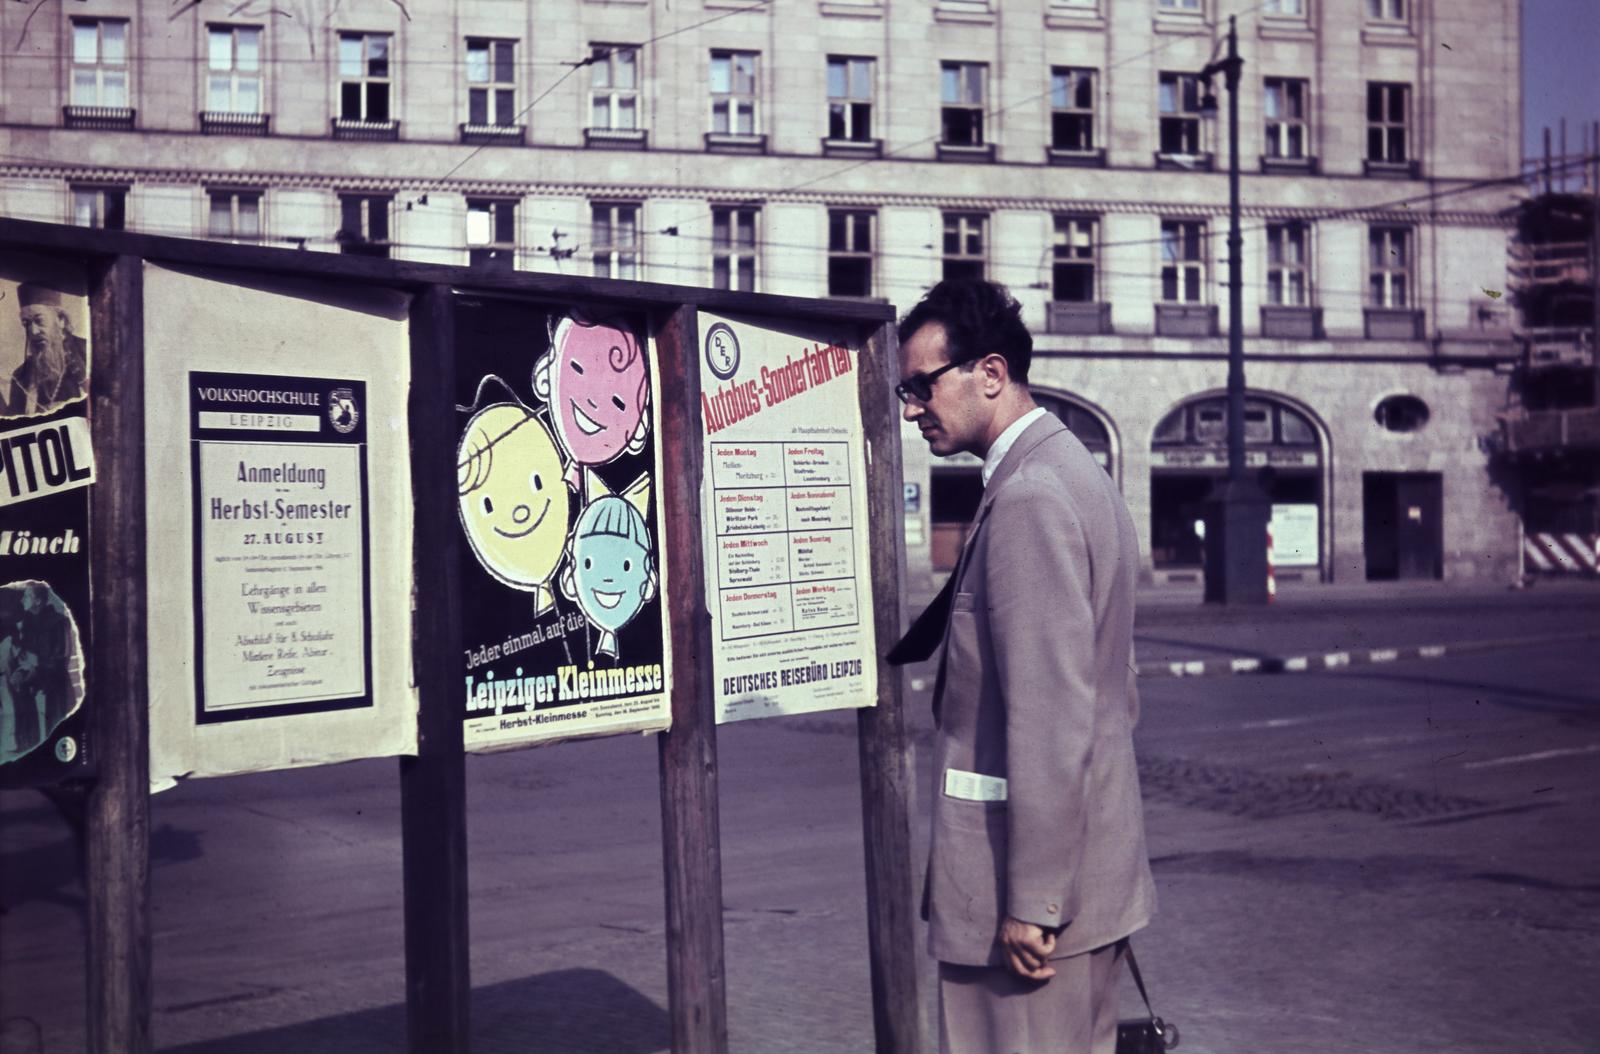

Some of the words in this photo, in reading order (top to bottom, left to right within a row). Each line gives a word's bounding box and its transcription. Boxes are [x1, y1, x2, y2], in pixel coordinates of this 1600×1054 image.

[715, 336, 731, 367] DER
[198, 387, 321, 406] VOLKSHOCHSCHULE
[701, 344, 853, 435] Autobus-Sonderfahrten
[230, 413, 294, 428] LEIPZIG
[0, 424, 91, 498] ITOL
[717, 448, 734, 456] Jeden
[735, 448, 757, 457] Montag
[804, 447, 824, 456] Freitag
[238, 461, 326, 490] Anmeldung
[738, 494, 763, 502] Dienstag
[211, 498, 352, 520] Herbst-Semester
[243, 533, 261, 545] 27.
[263, 532, 324, 545] AUGUST
[723, 541, 739, 549] Jeden
[241, 583, 290, 599] Lehrgänge
[306, 582, 327, 593] allen
[726, 594, 743, 602] Jeden
[796, 587, 812, 595] Jeden
[812, 585, 836, 594] Werktag
[465, 645, 501, 670] Jeder
[502, 624, 546, 656] einmal
[547, 615, 566, 639] auf
[566, 612, 585, 631] die
[724, 671, 778, 695] DEUTSCHES
[781, 661, 828, 687] REISEBÜRO
[831, 659, 862, 679] LEIPZIG
[465, 667, 557, 715] Leipziger
[557, 660, 662, 700] Kleinmesse
[500, 710, 588, 730] Herbst-Kleinmesse
